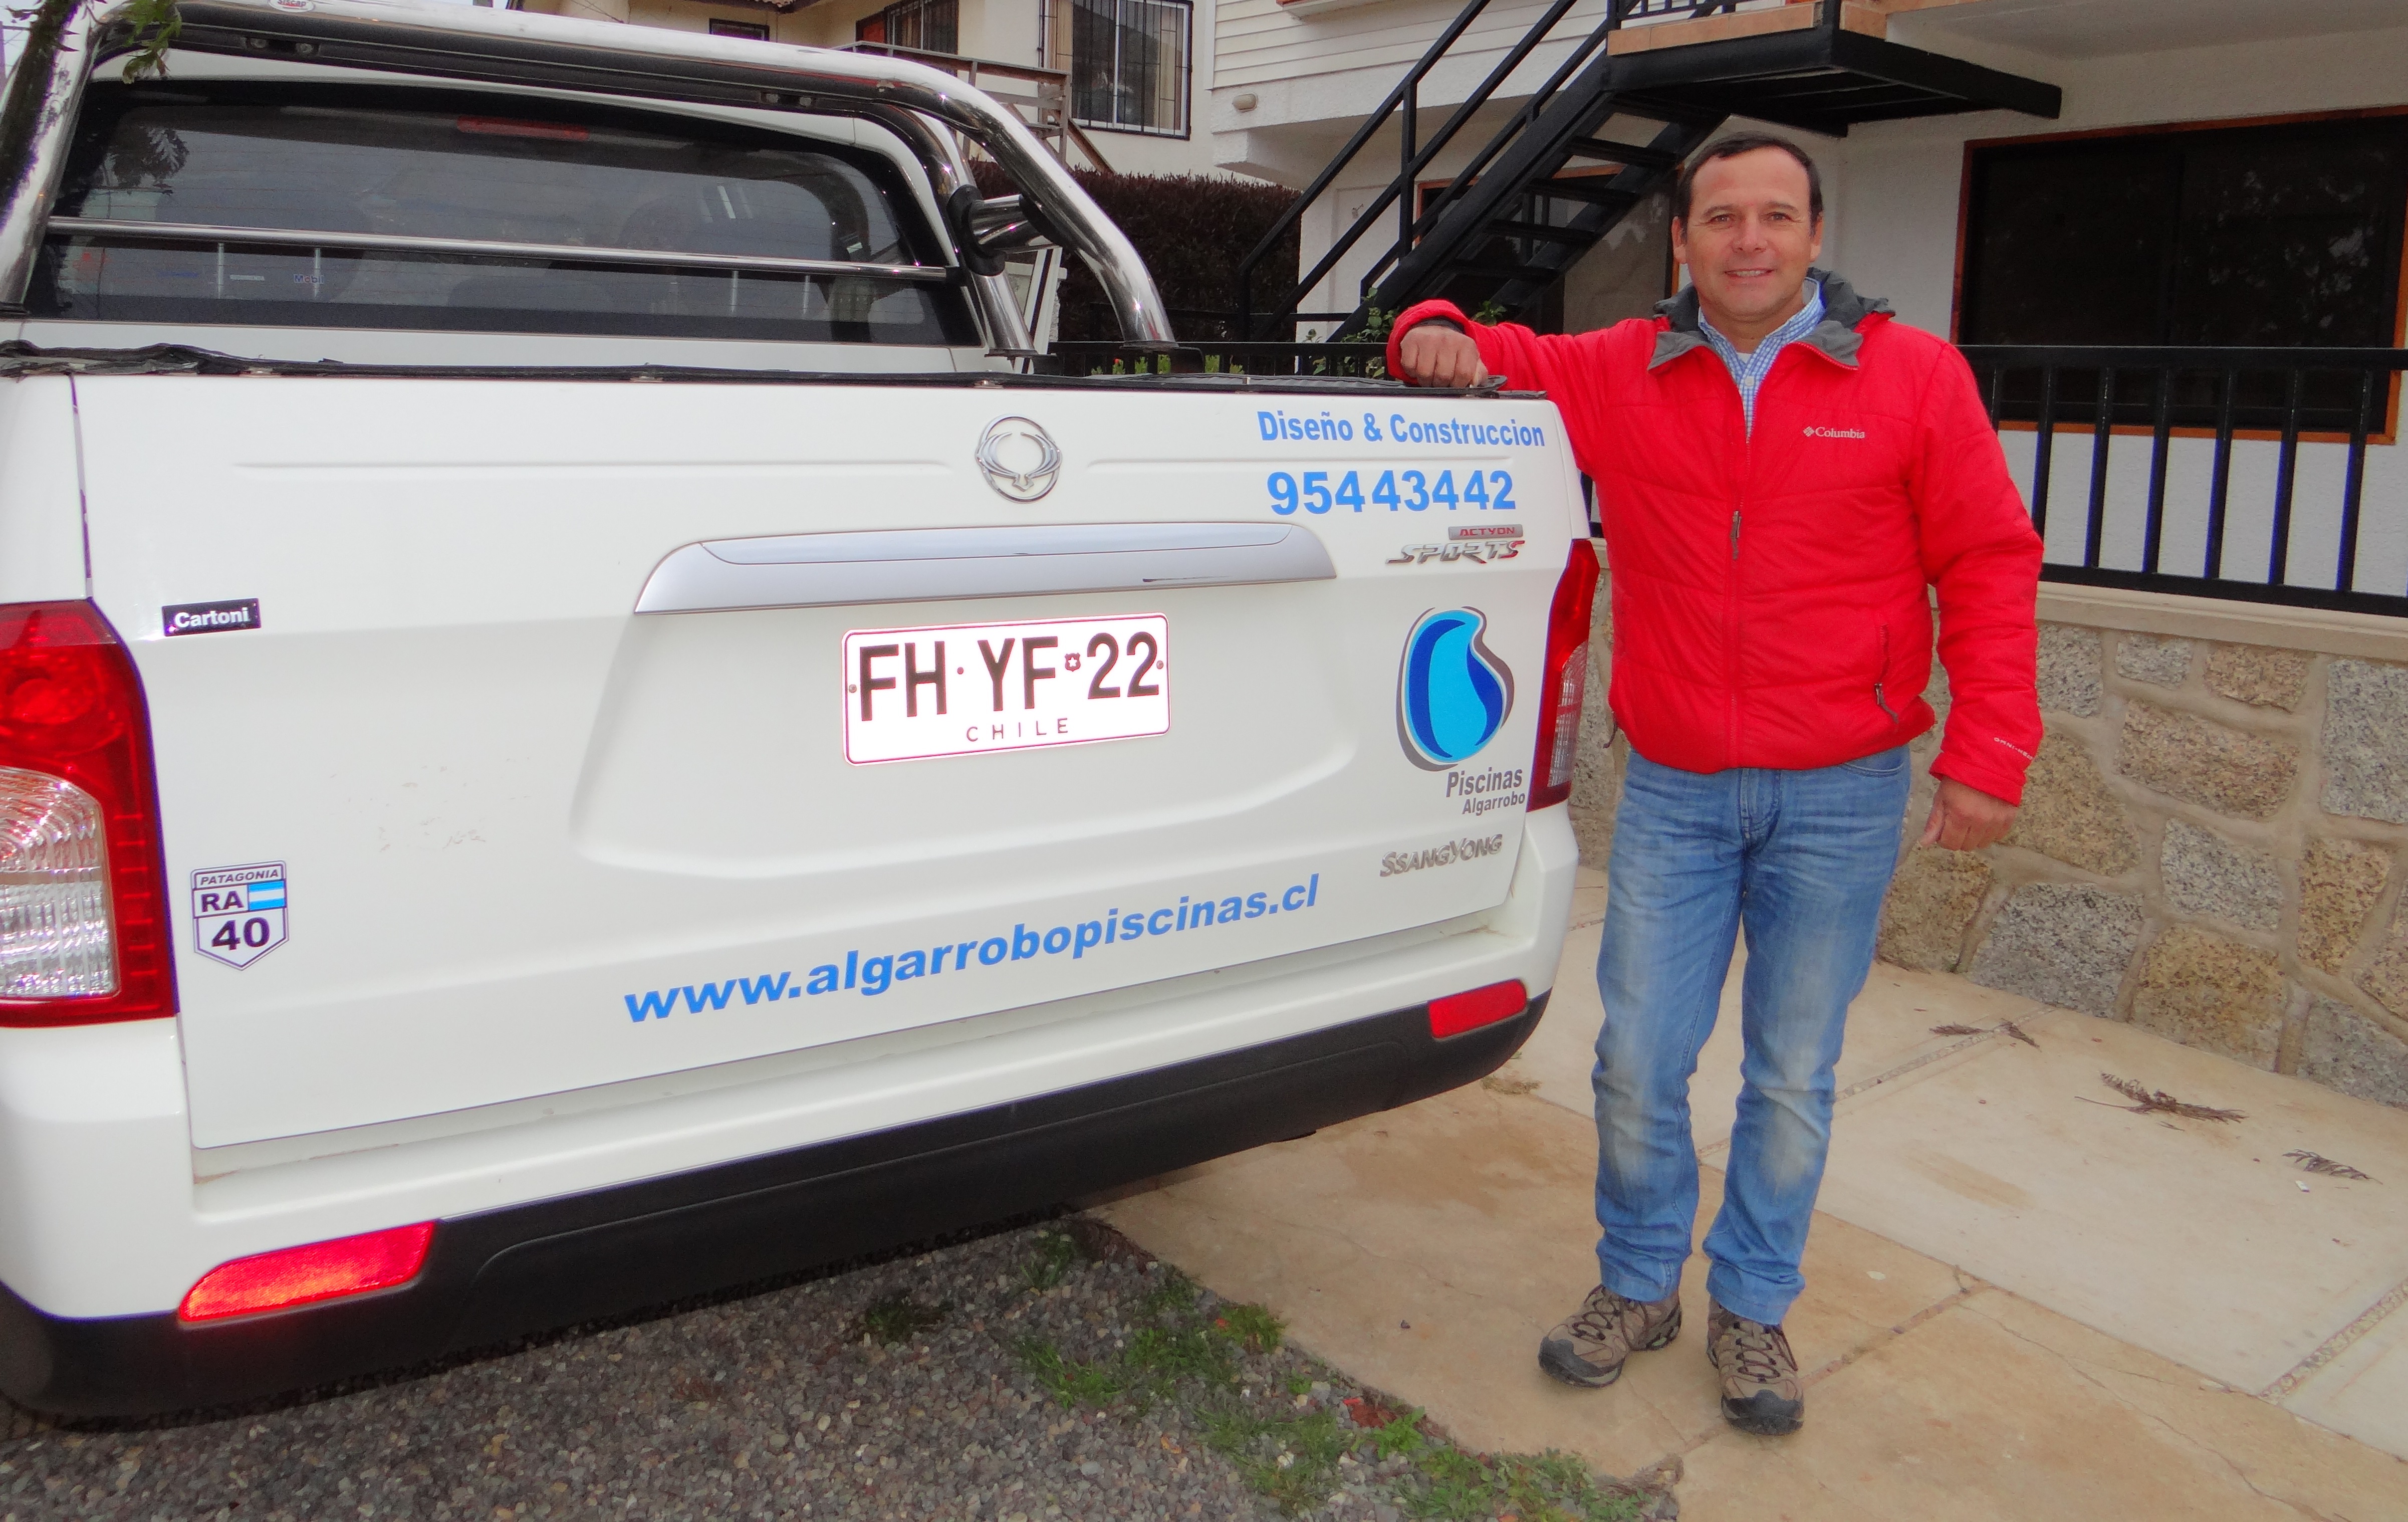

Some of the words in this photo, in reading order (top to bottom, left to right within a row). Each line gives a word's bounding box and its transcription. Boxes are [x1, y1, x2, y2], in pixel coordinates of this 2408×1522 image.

[293, 274, 324, 284] Mobil
[1257, 410, 1353, 442] Diseño
[1363, 412, 1383, 443] &
[1389, 413, 1545, 447] Construccion
[1815, 426, 1865, 439] Columbia
[1267, 469, 1517, 516] 95443442
[1460, 527, 1515, 536] ACTYON
[1385, 540, 1525, 564] SPORTS
[174, 607, 250, 627] Cartoni
[966, 717, 1068, 742] CHILE
[1994, 737, 2033, 760] OMNI-HEA
[1446, 767, 1523, 798] Piscinas
[1462, 791, 1526, 816] Algarrobo
[200, 868, 279, 886] PATAGONIA
[201, 890, 245, 913] RA
[211, 917, 271, 951] 40
[624, 873, 1320, 1023] www.algarrobopiscinas.cl
